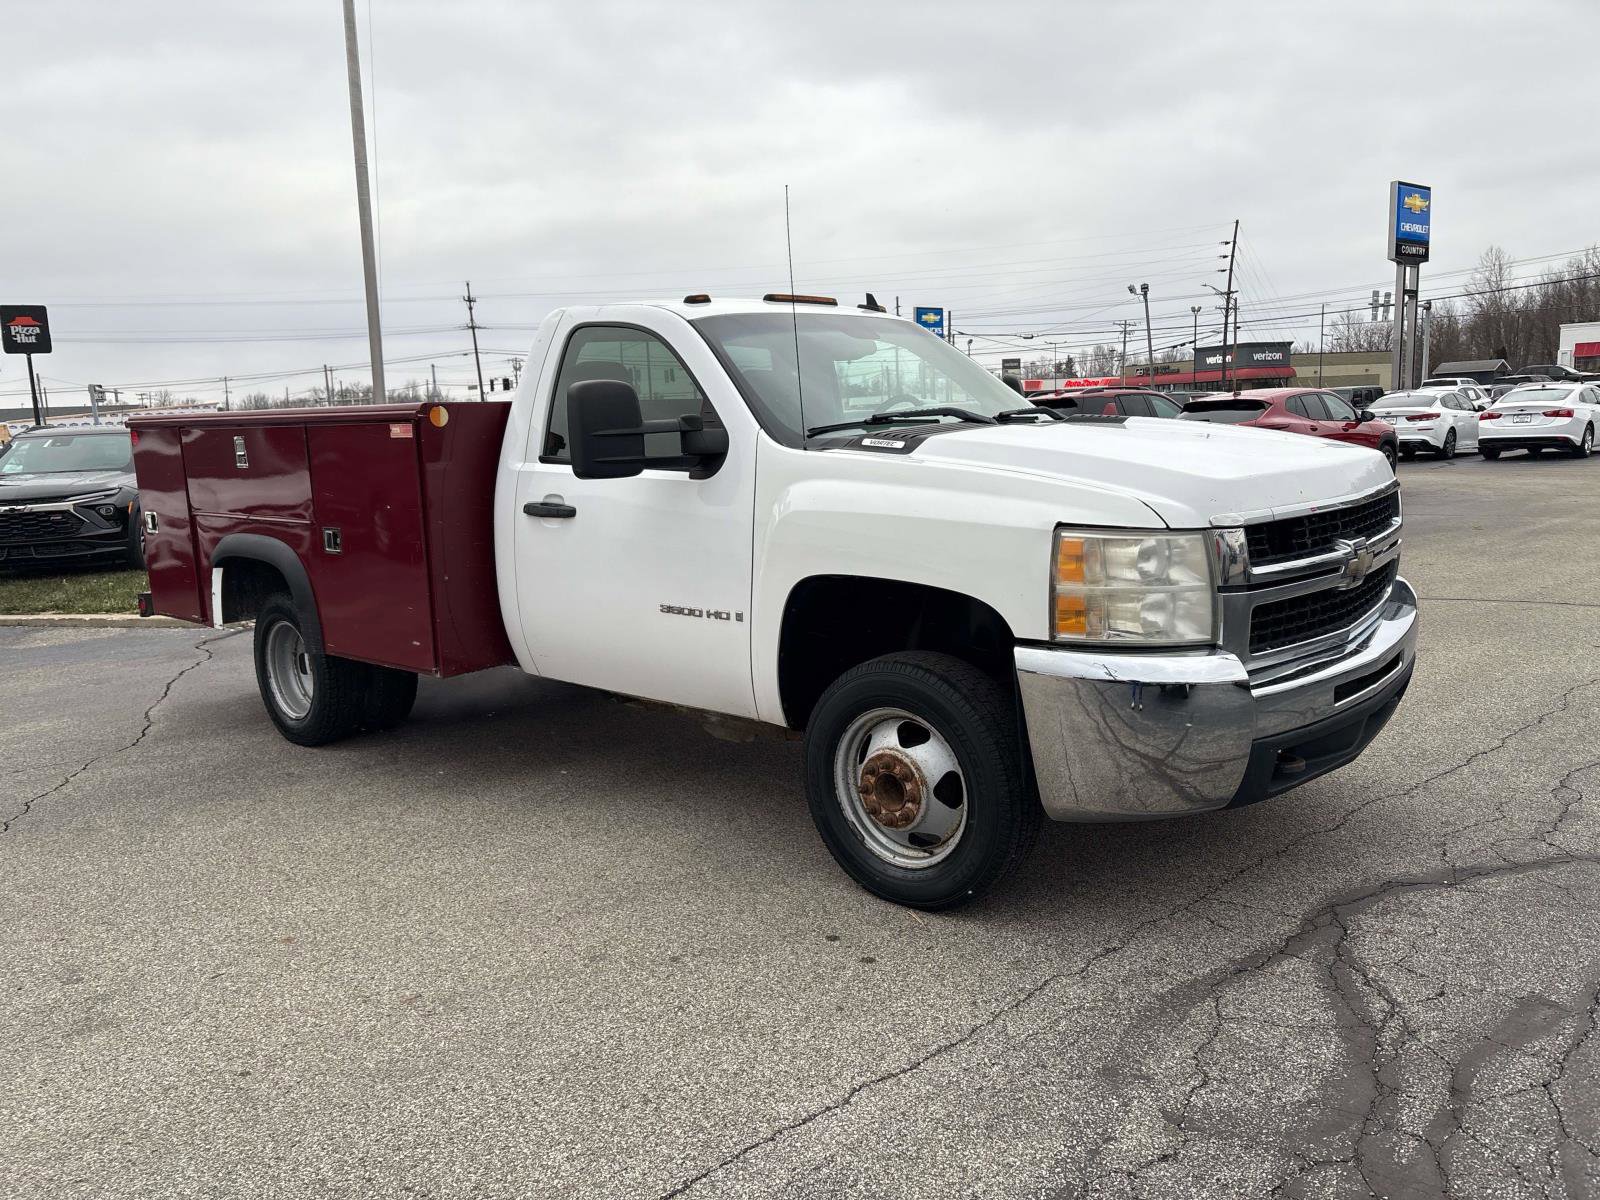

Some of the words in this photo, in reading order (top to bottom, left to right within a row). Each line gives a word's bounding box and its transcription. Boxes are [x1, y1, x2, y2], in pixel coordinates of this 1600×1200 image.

[1400, 222, 1429, 234] CHEVROLET
[1401, 245, 1426, 256] COUNTRY
[10, 325, 41, 336] Pizza
[11, 333, 38, 344] Hut
[1206, 353, 1232, 365] verizn
[1252, 350, 1283, 361] verizon
[869, 439, 898, 447] VORTEC
[705, 609, 731, 621] HD
